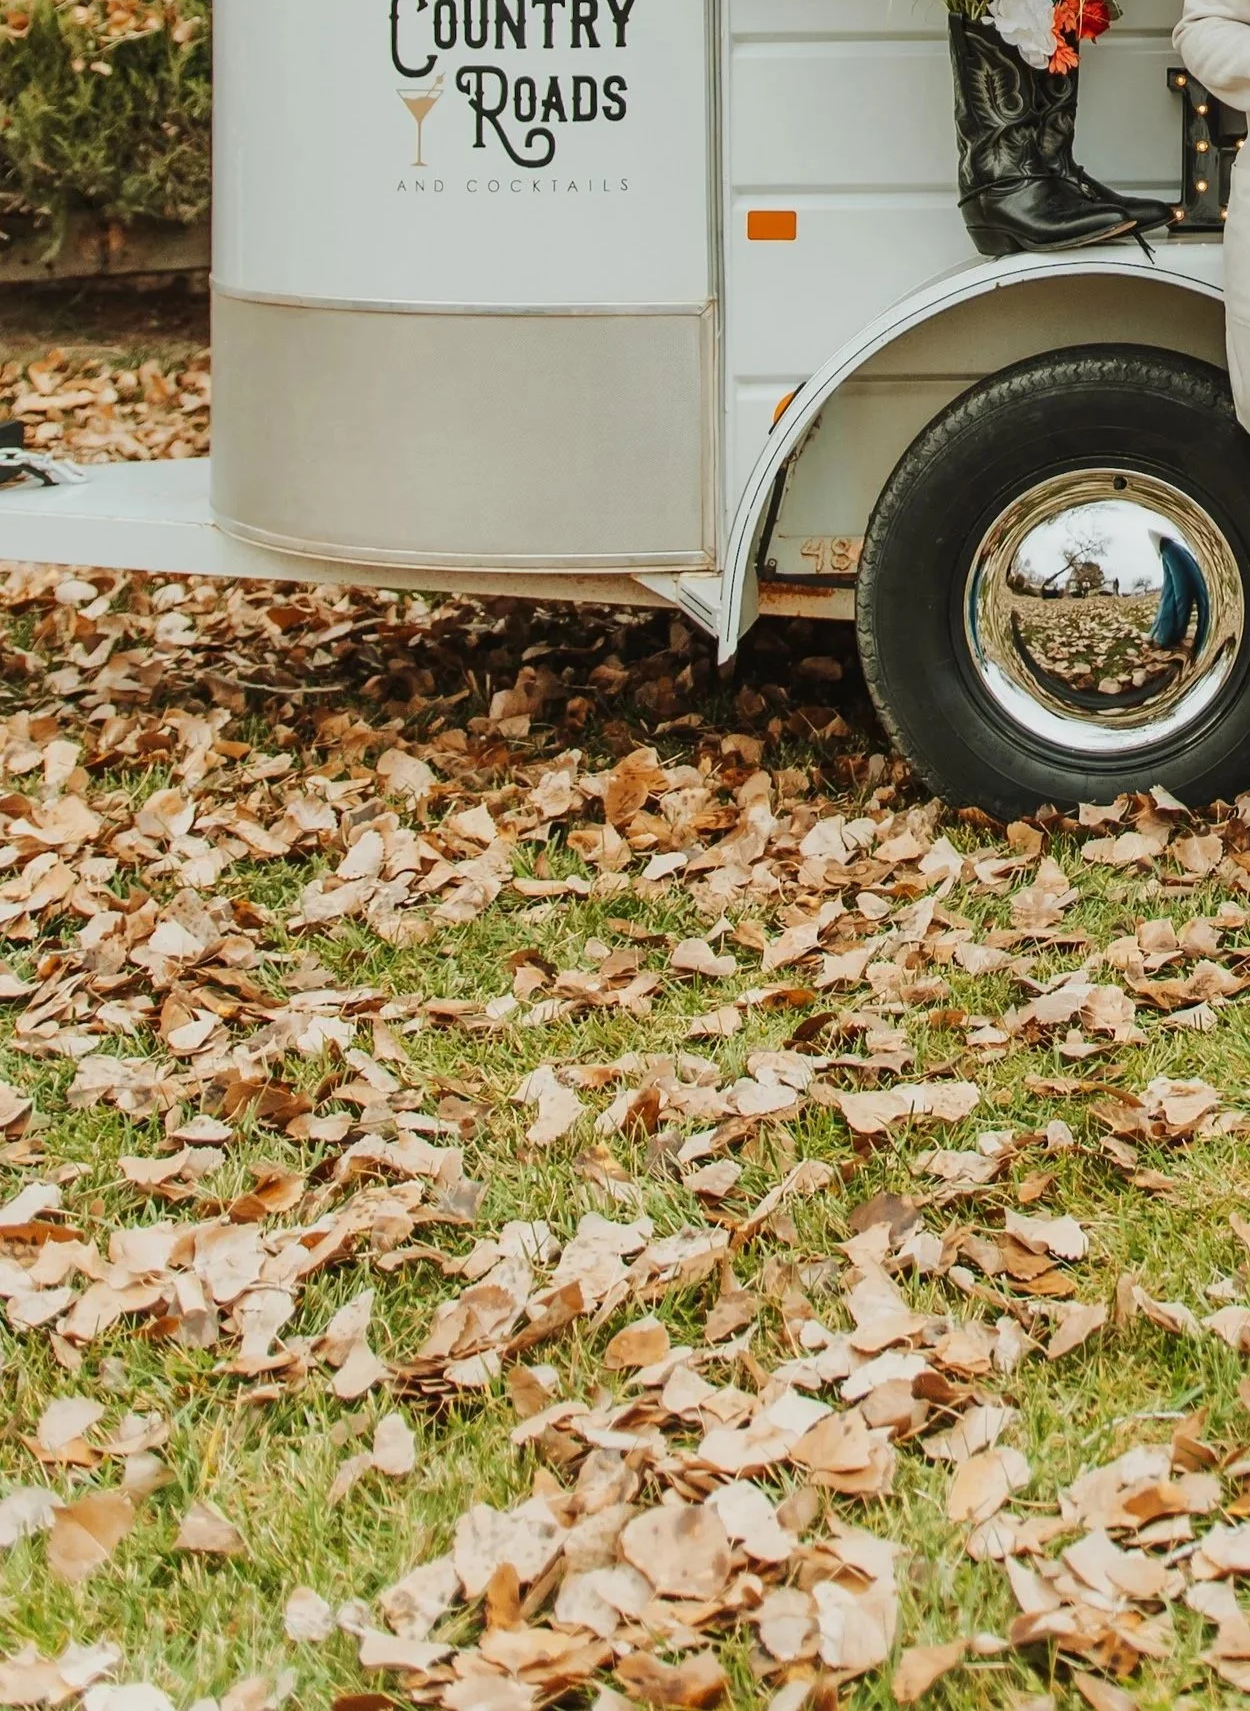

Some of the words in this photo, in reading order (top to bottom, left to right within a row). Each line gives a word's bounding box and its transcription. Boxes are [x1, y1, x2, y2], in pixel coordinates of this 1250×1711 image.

[455, 65, 628, 168] ROADS
[396, 179, 445, 192] AND
[466, 178, 630, 192] COCKTAILS
